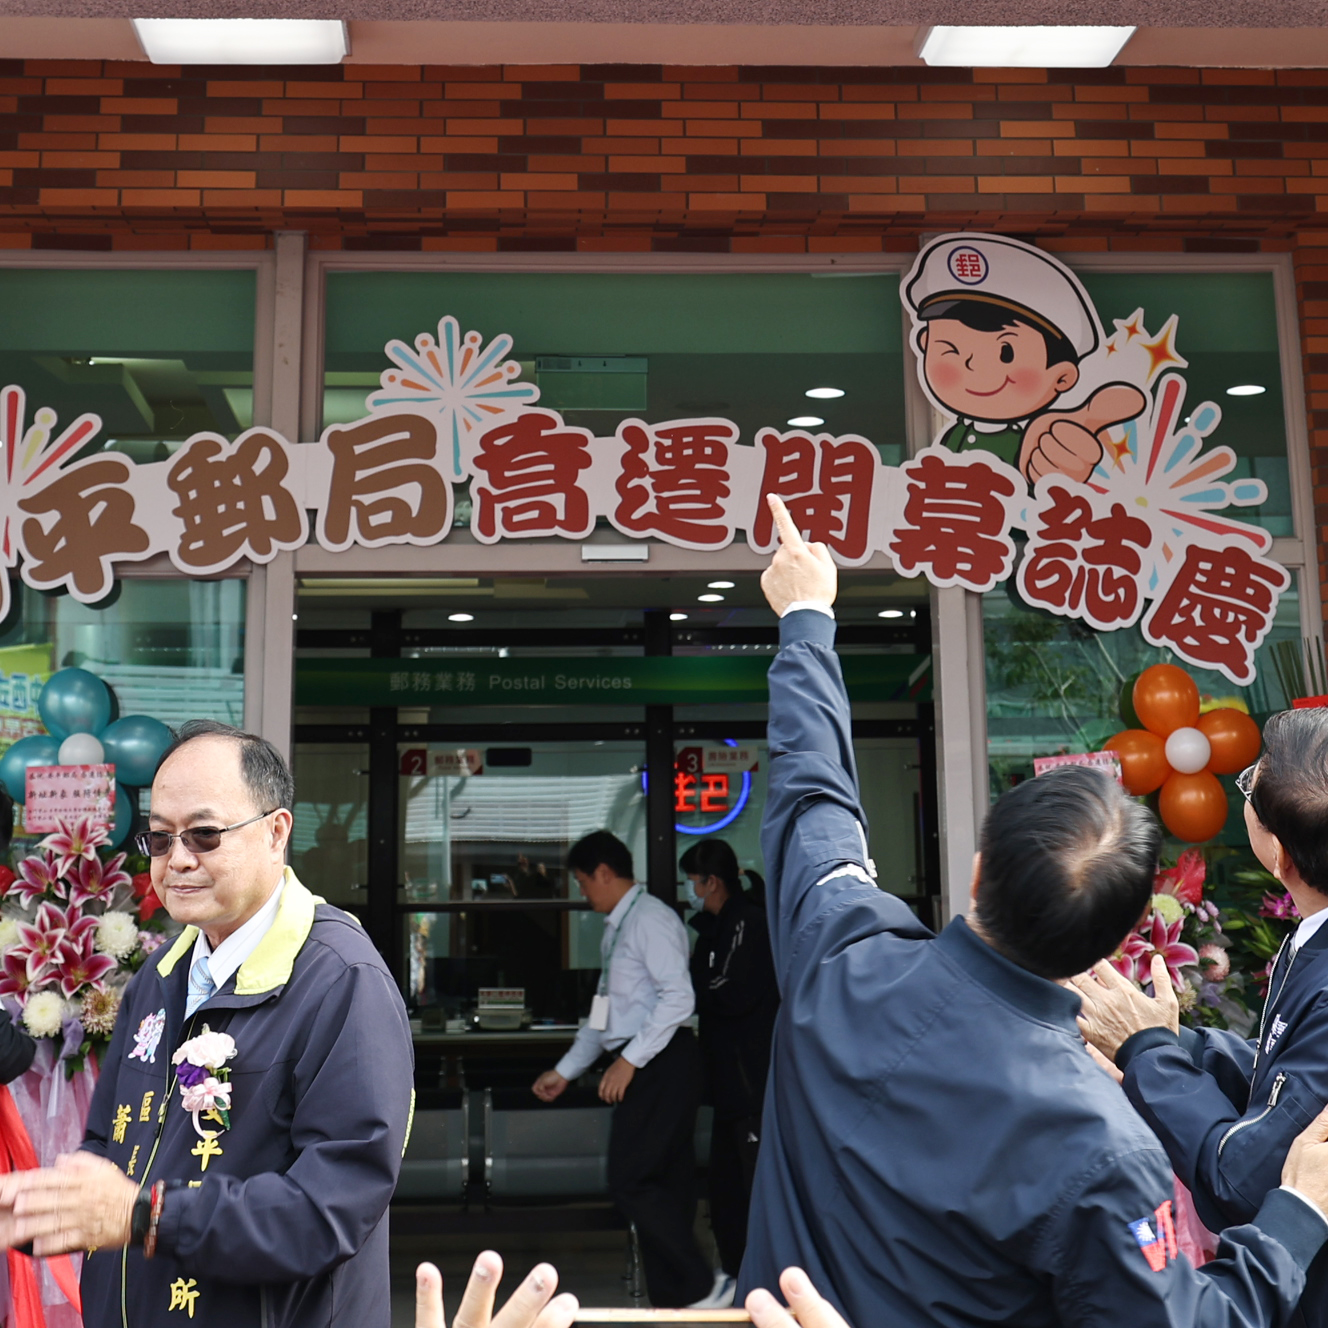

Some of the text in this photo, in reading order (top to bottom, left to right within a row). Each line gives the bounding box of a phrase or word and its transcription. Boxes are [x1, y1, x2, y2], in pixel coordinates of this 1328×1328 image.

[955, 253, 982, 278] 郵
[389, 672, 632, 691] 郵務業務 Postal Services
[411, 756, 422, 774] 2
[687, 753, 698, 772] 3
